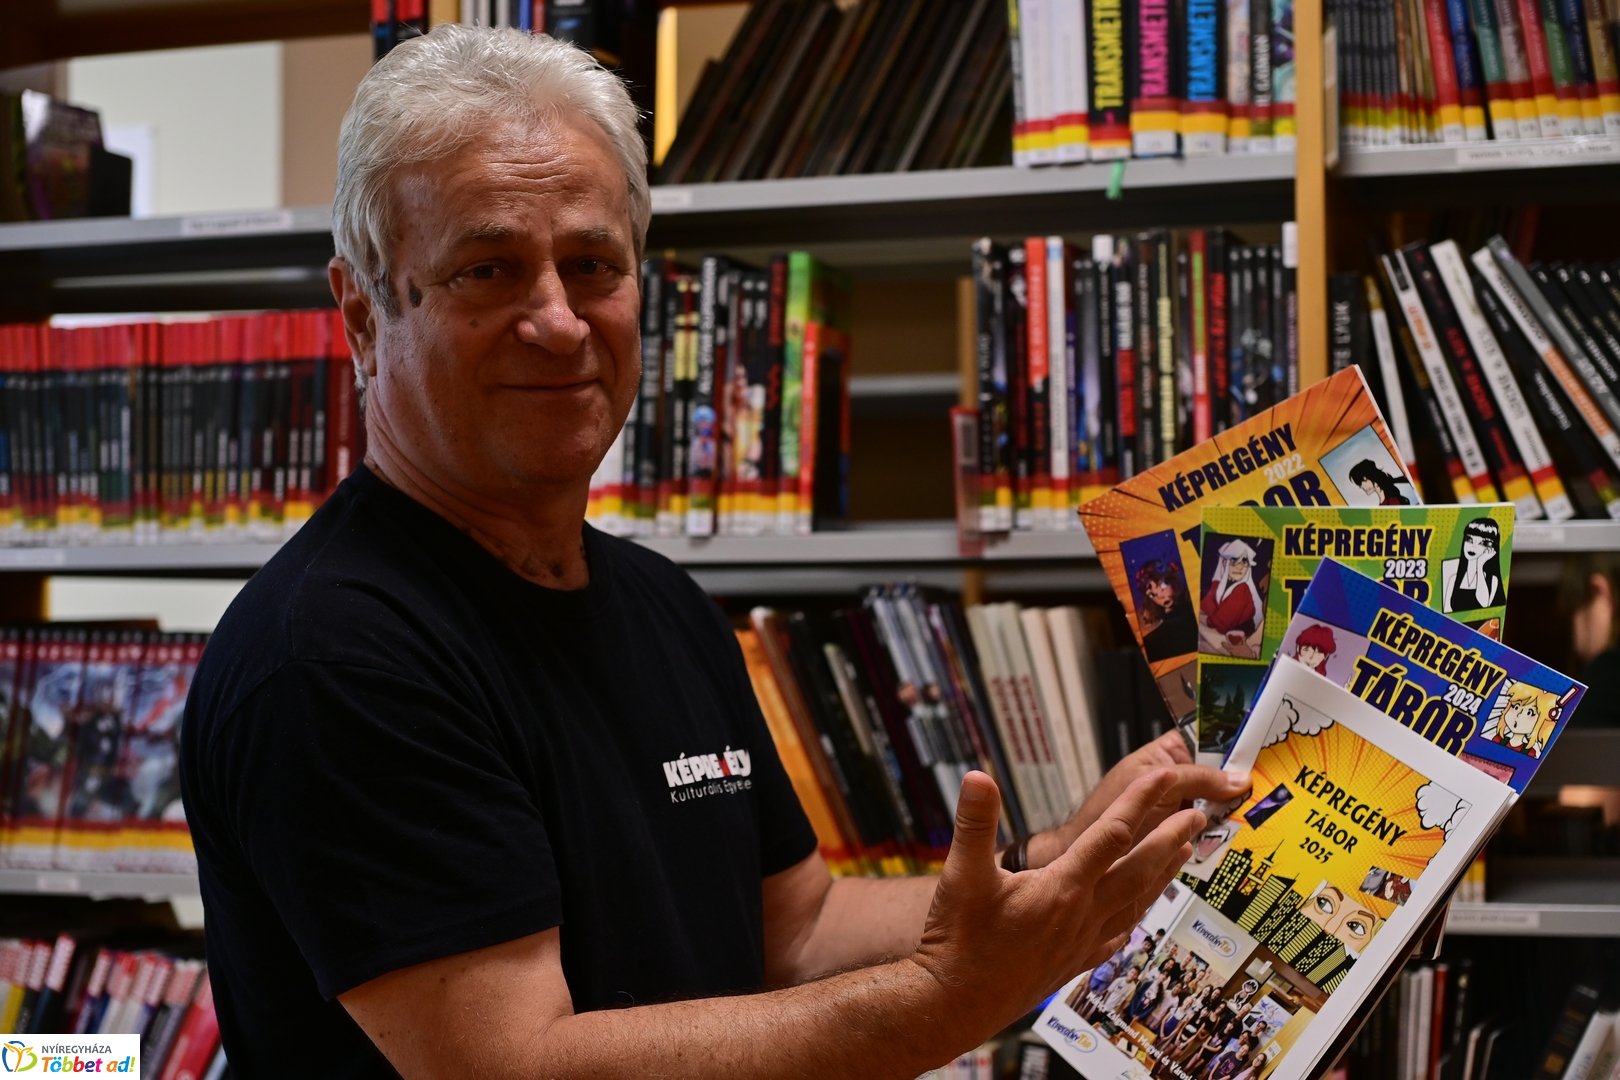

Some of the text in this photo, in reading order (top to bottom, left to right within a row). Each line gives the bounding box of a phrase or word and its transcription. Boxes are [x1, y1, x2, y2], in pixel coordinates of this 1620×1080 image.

[1158, 423, 1296, 512] KÉPREGÉNY
[1264, 453, 1305, 484] 2022
[1286, 523, 1432, 556] KÉPREGÉNY
[1385, 559, 1426, 578] 2023
[1372, 611, 1503, 696] KÉPREGÉNY
[1443, 685, 1480, 714] 2024
[1294, 765, 1407, 846] KÉPREGÉNY
[1300, 837, 1333, 863] 2025
[1304, 809, 1358, 853] TÁBOR
[1107, 1010, 1140, 1039] Zsigmond
[1137, 1035, 1163, 1059] Megyei
[1161, 1055, 1171, 1066] és
